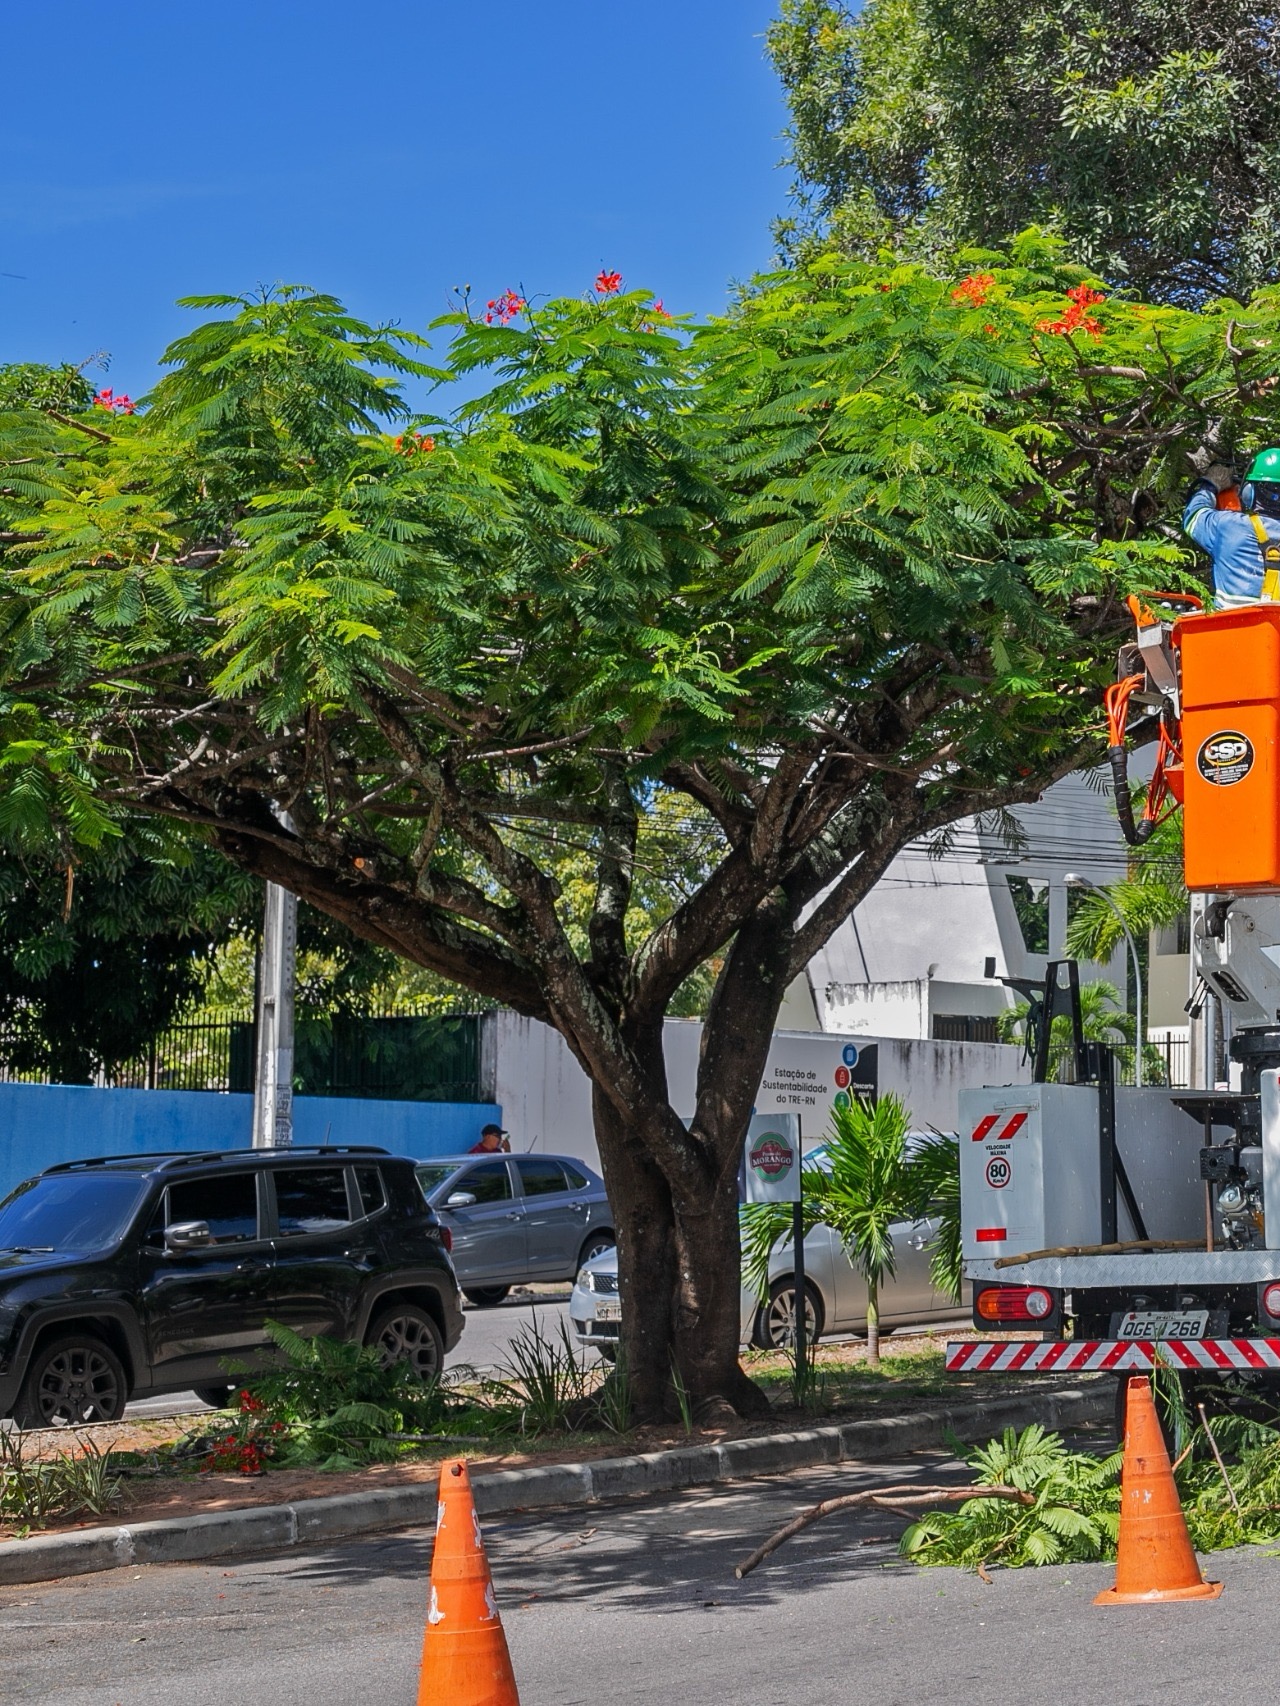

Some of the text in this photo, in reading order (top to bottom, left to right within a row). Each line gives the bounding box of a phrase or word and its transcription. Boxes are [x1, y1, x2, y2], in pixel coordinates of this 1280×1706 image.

[775, 1068, 816, 1081] Estação de
[762, 1080, 828, 1094] Sustentabilidade
[776, 1095, 816, 1105] do TRE-RN
[985, 1143, 1012, 1151] VELOCIDADE
[752, 1156, 792, 1166] MORANGO
[990, 1164, 1007, 1178] 80
